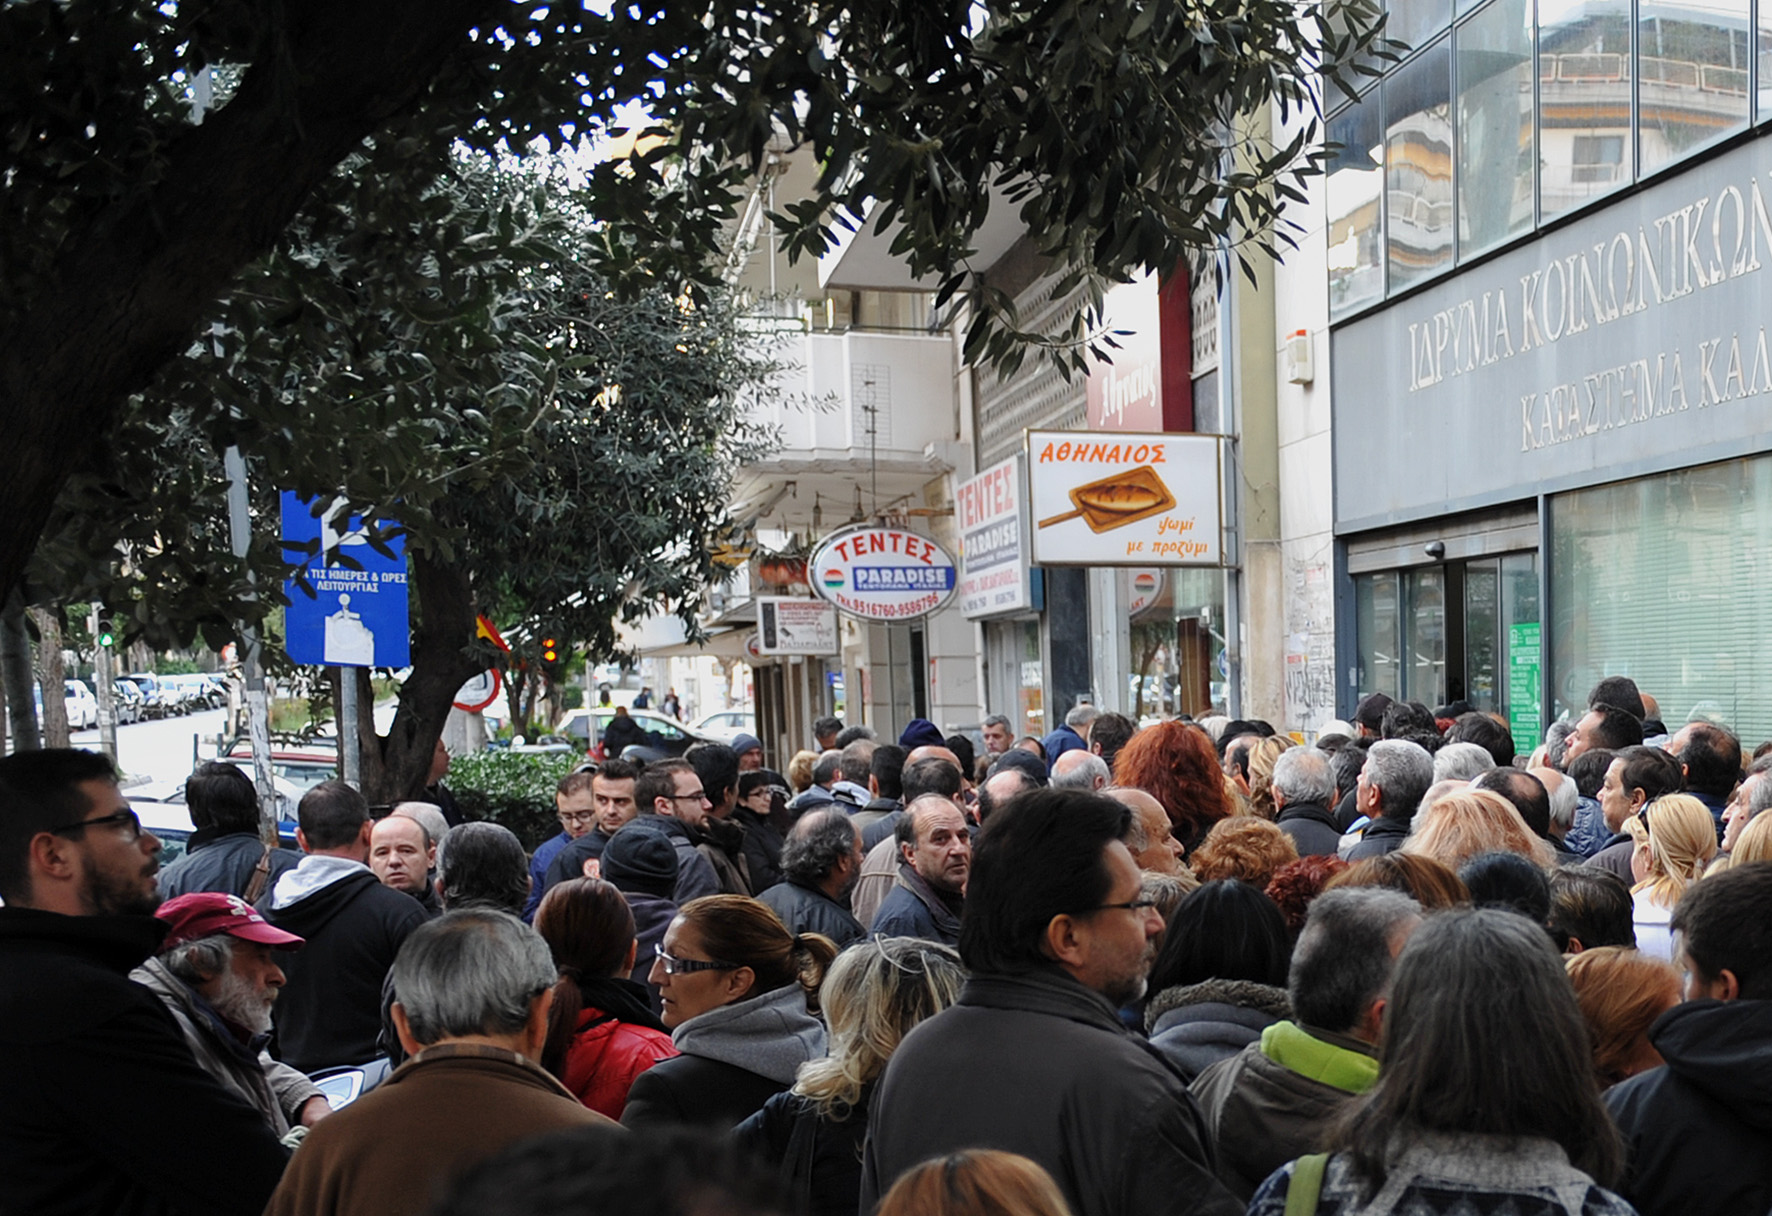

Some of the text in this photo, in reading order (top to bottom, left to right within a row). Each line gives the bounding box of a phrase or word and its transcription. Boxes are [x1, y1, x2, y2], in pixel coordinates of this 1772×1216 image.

[1409, 288, 1514, 392] ΙΔΡΥΜΑ
[1521, 348, 1689, 453] ΚΑΤΑΣΤΗΜΑ
[1039, 442, 1167, 464] ΑΘΗΝΑΙΟΣ
[957, 464, 1014, 530] ΤΕΝΤΕΣ
[1157, 516, 1196, 535] ψωμί
[834, 532, 936, 566] ΤΕΝΤΕΣ
[1126, 539, 1208, 558] με προζύμι
[310, 568, 327, 580] ΤΙΣ
[329, 570, 369, 582] ΗΜΕΡΕΣ
[381, 573, 407, 584] ΩΡΕΣ
[855, 568, 946, 584] PARADISE
[317, 581, 379, 593] ΛΕΙΤΟΥΡΓΙΑΣ
